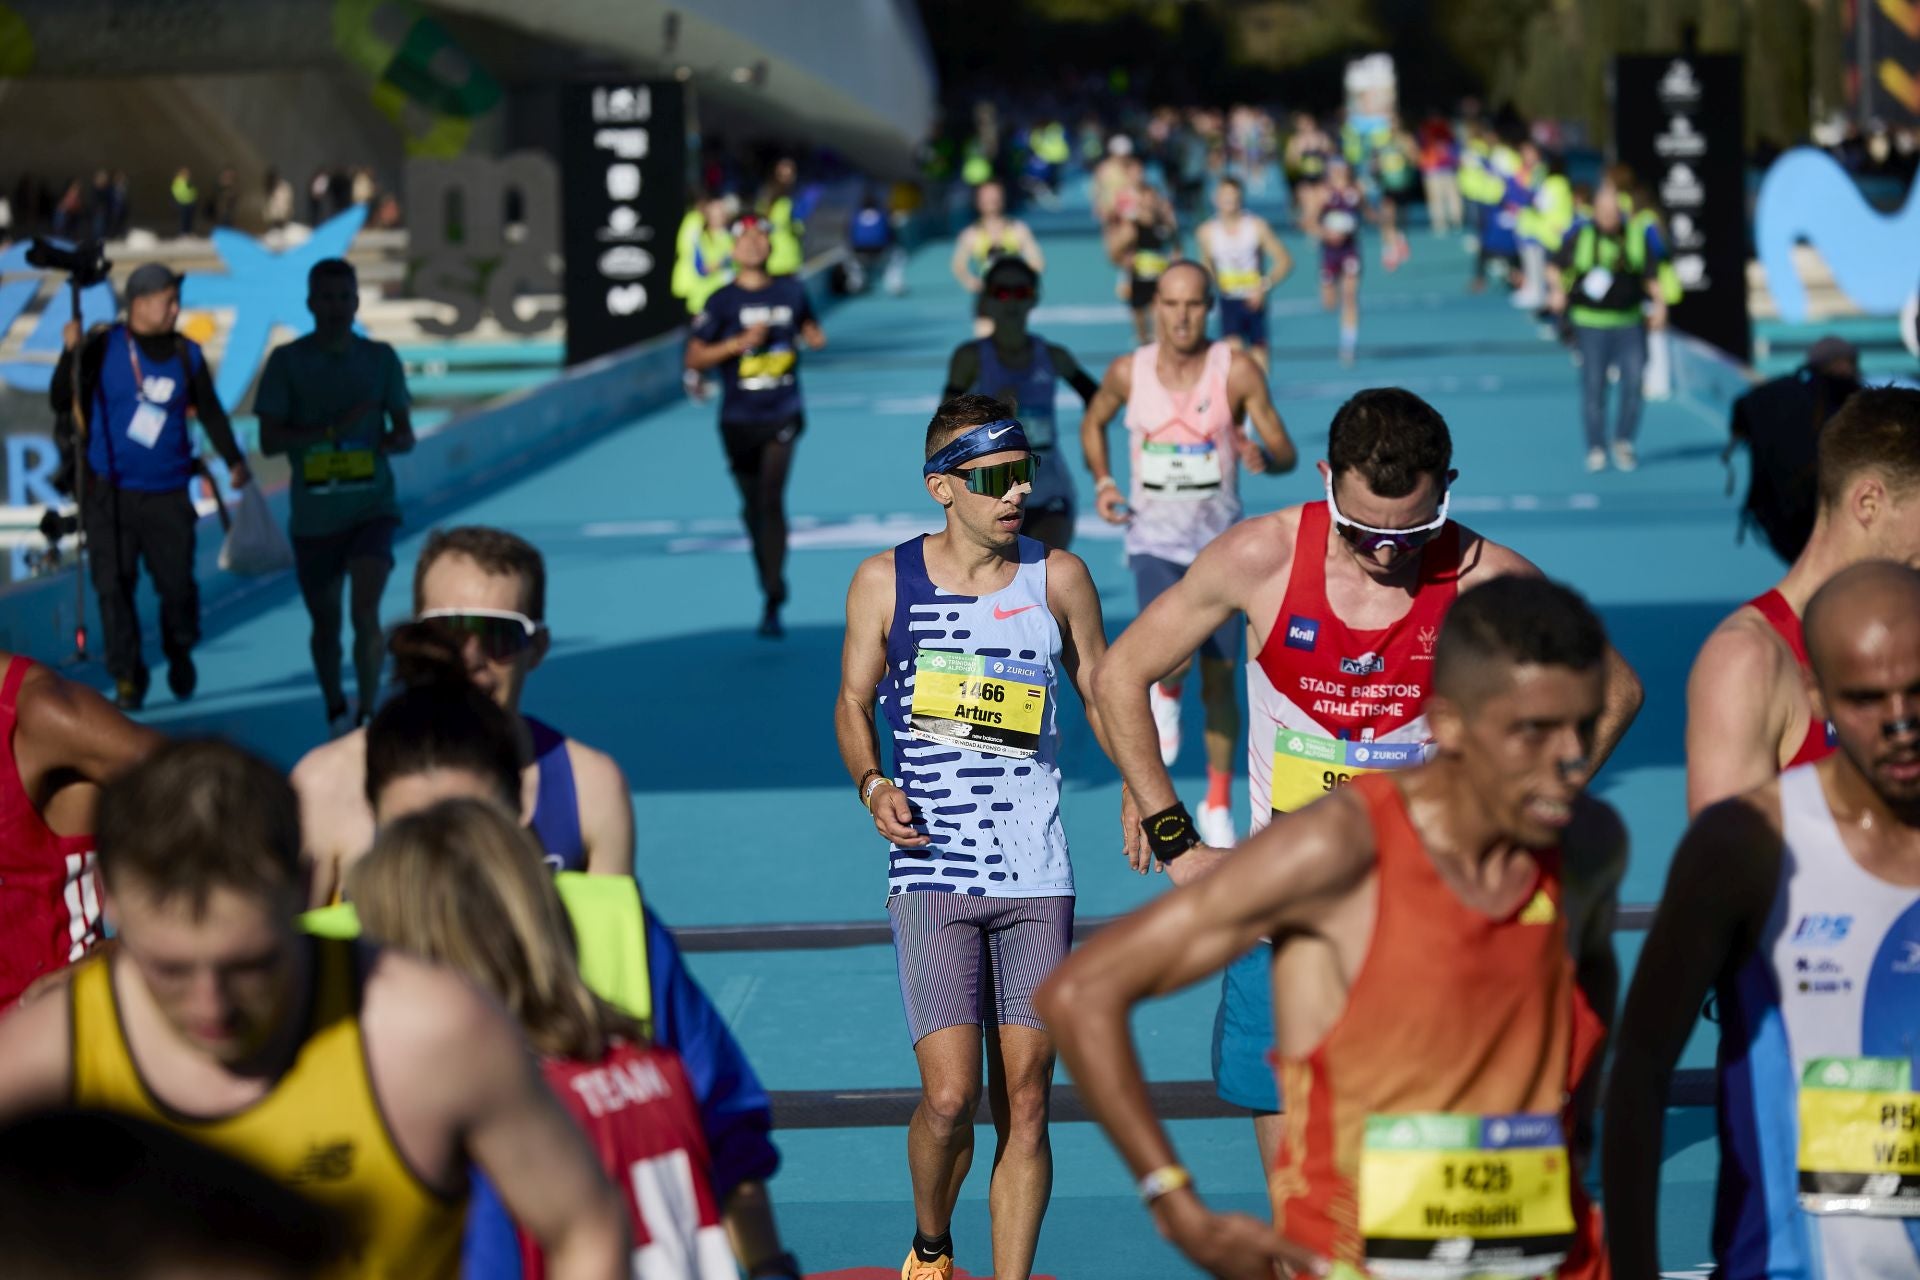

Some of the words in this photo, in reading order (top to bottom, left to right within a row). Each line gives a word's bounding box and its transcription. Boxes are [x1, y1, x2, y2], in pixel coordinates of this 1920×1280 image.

[1289, 626, 1315, 642] Krill
[948, 659, 976, 667] TRINIDAD
[1006, 666, 1036, 677] ZURICH
[959, 681, 1005, 703] 1466
[1300, 676, 1346, 697] STADE
[1352, 684, 1421, 699] BRESTOIS
[954, 704, 1003, 724] Arturs
[1313, 699, 1404, 717] ATHLÉTISME
[1373, 750, 1407, 760] ZURICH
[1881, 1103, 1920, 1131] 85
